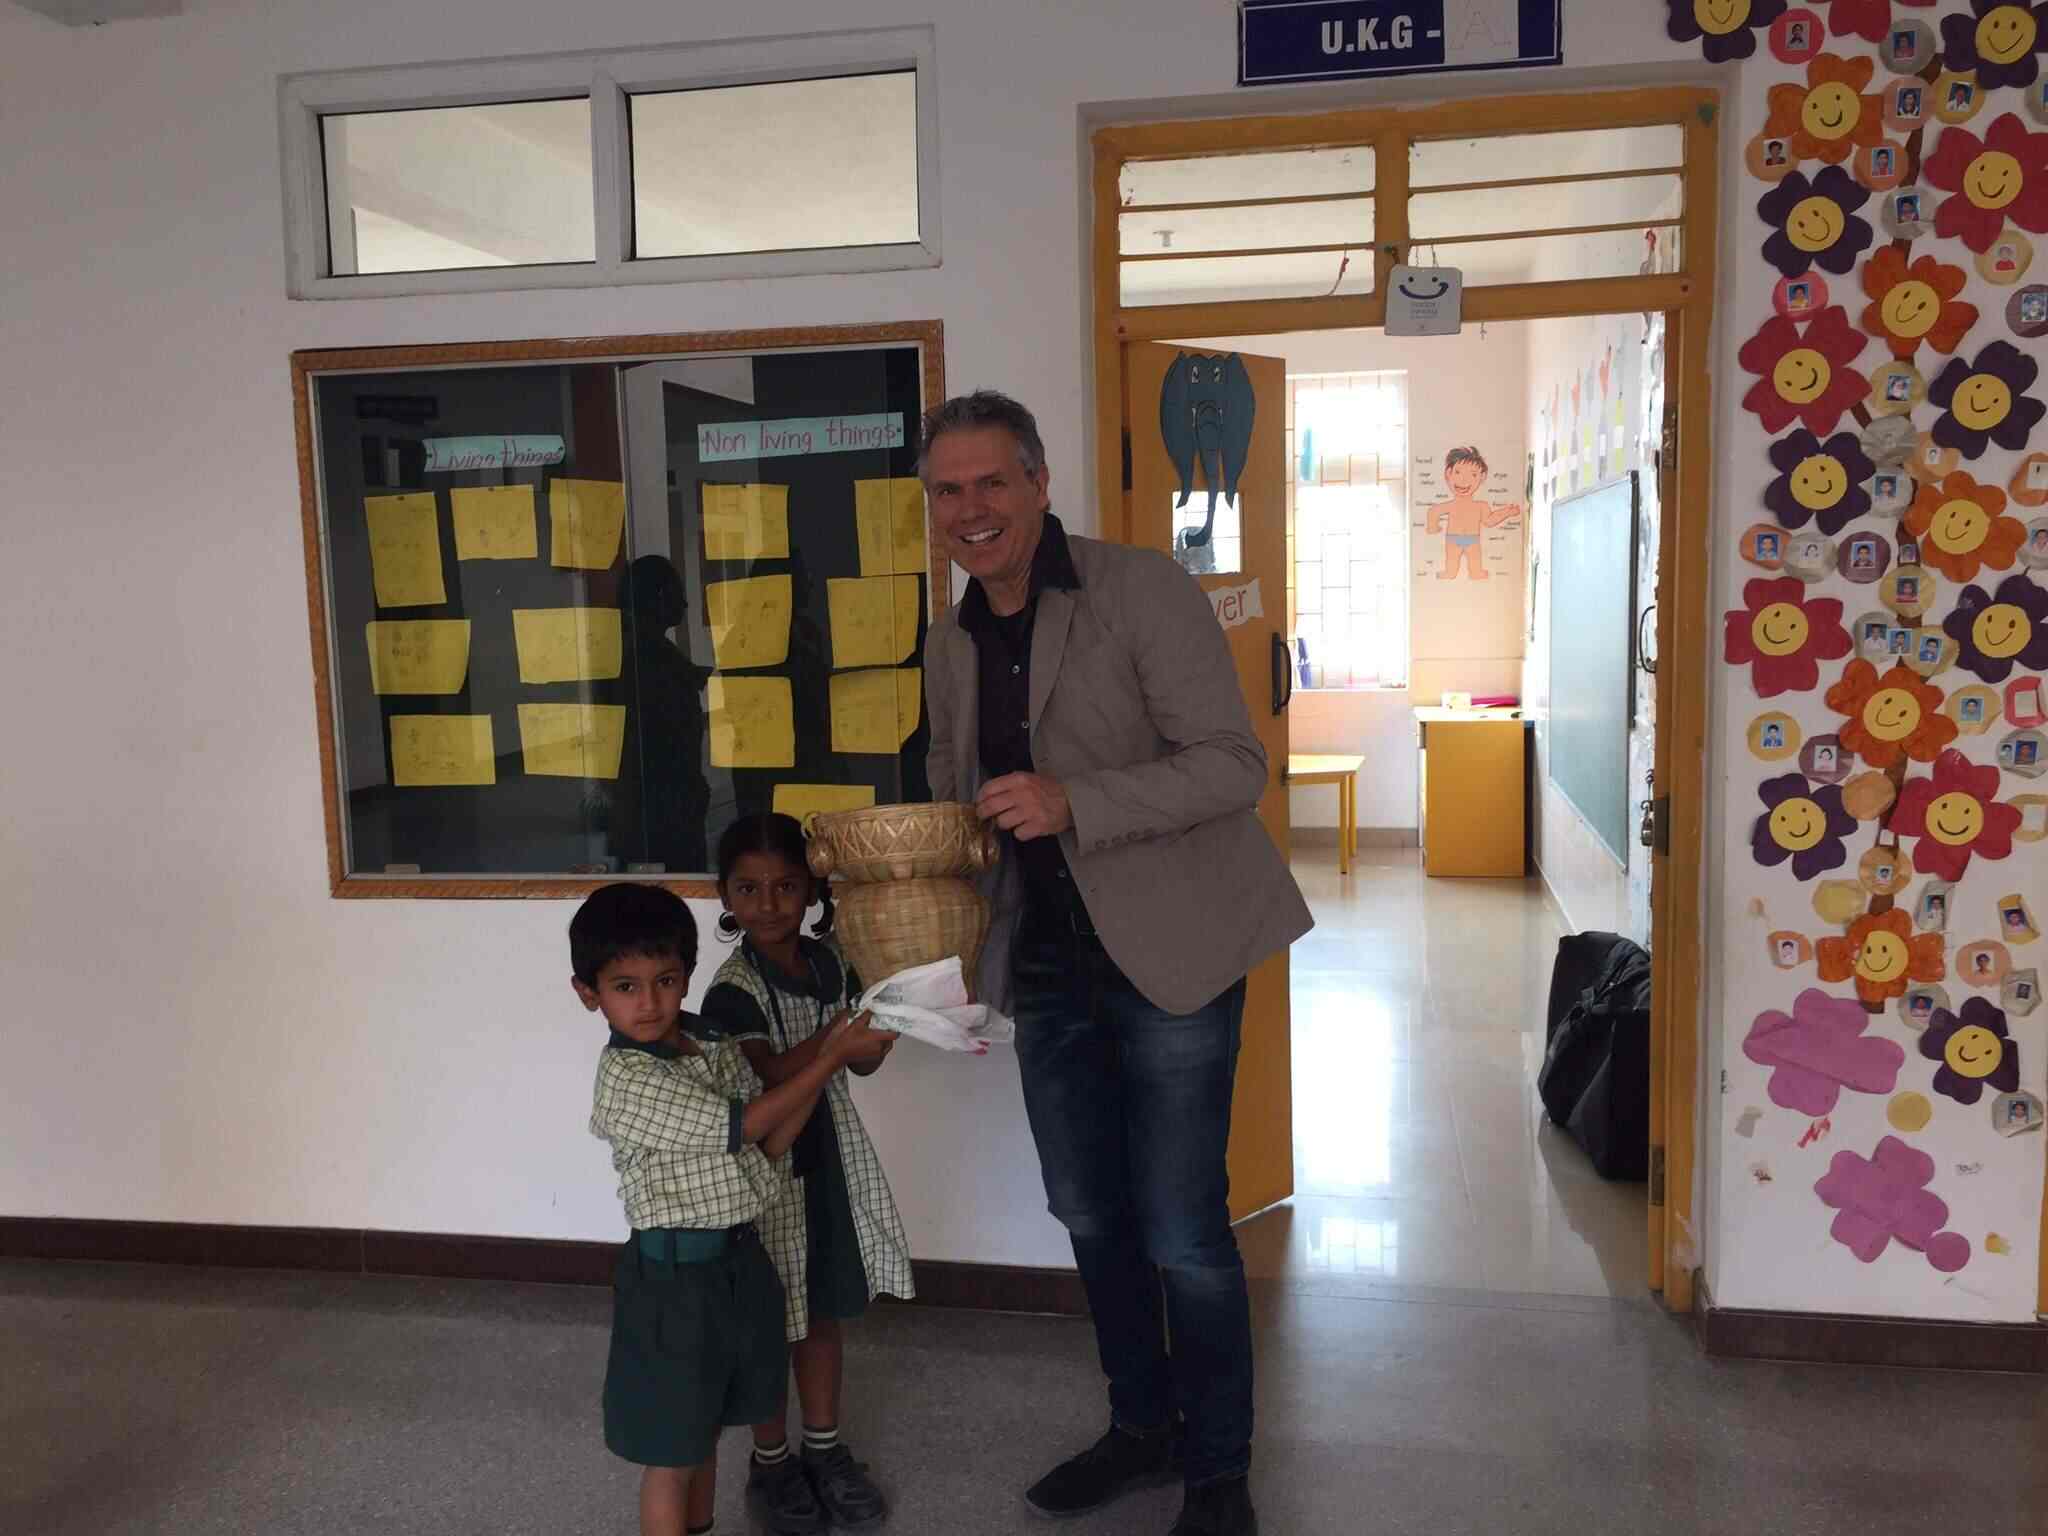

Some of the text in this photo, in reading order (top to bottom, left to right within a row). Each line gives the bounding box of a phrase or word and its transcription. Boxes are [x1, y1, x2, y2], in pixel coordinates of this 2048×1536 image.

[1321, 14, 1413, 55] U.K.G
[431, 439, 561, 470] Living things
[703, 420, 897, 455] Non living things
